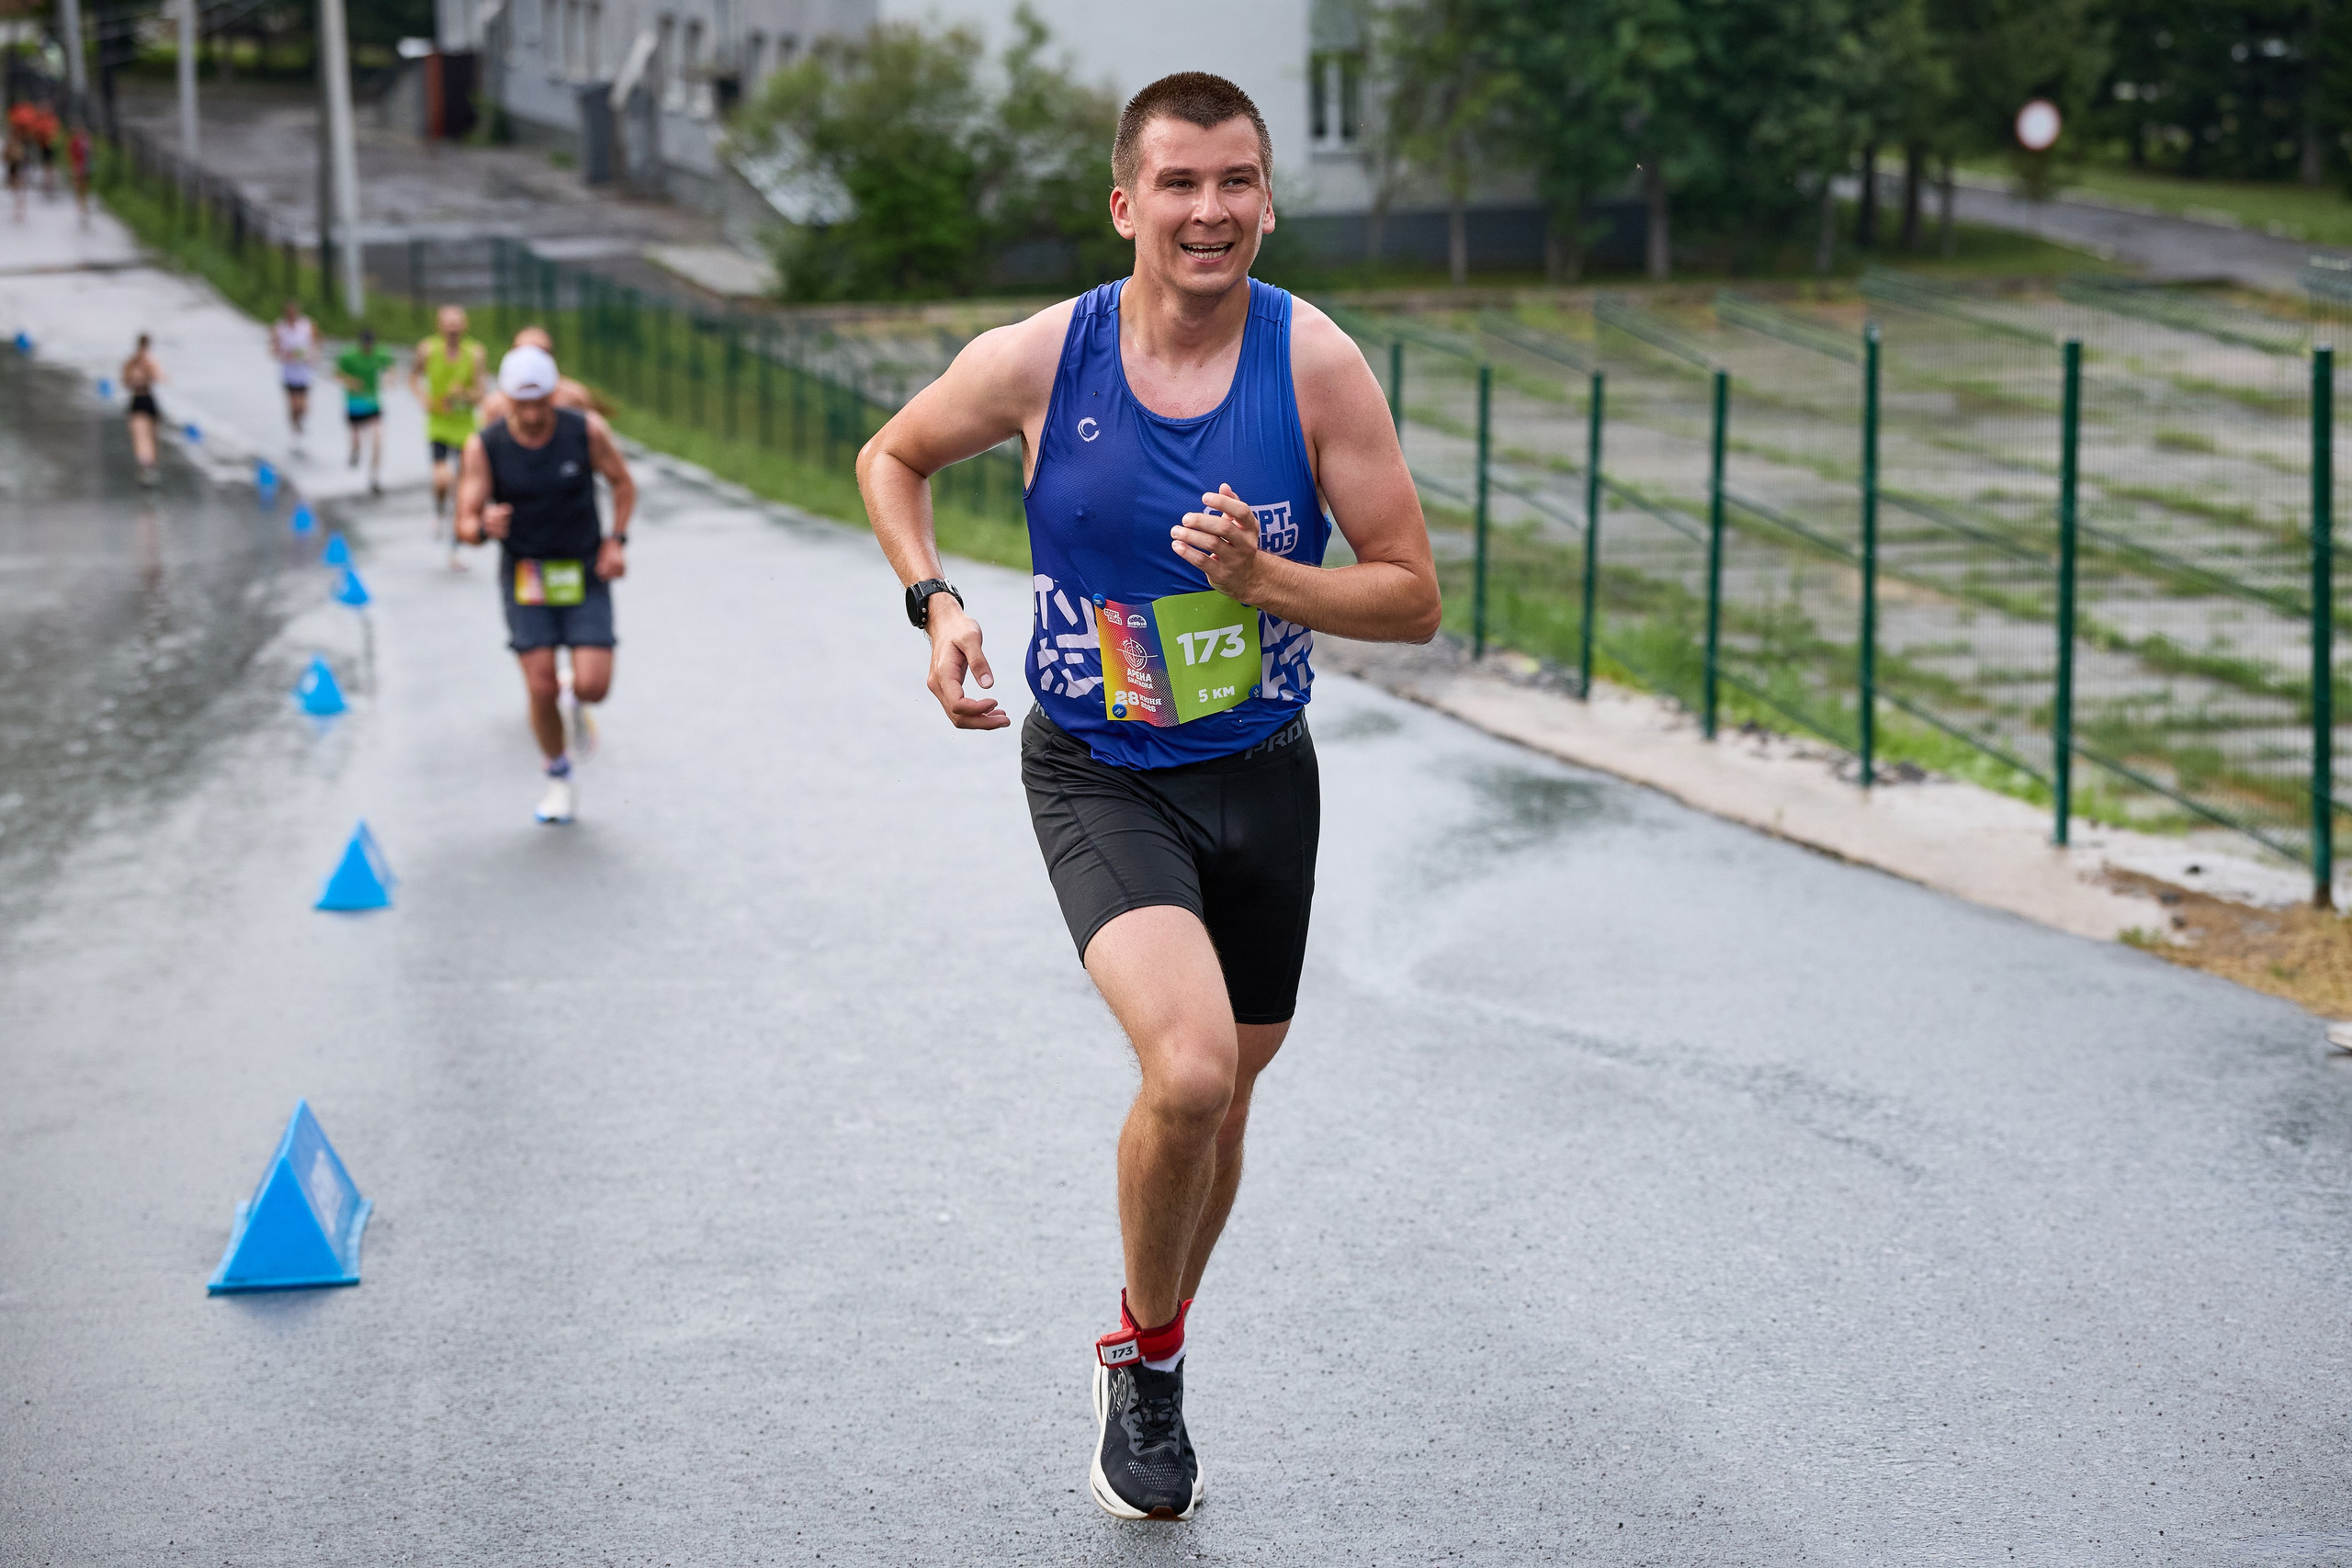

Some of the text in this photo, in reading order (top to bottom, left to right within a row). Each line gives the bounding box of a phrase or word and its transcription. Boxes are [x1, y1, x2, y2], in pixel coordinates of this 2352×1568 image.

[1176, 624, 1246, 666] 173
[1127, 668, 1152, 682] АРЕНА
[1114, 690, 1139, 705] 28
[1198, 686, 1235, 703] 5 КМ
[1112, 1346, 1133, 1359] 173
